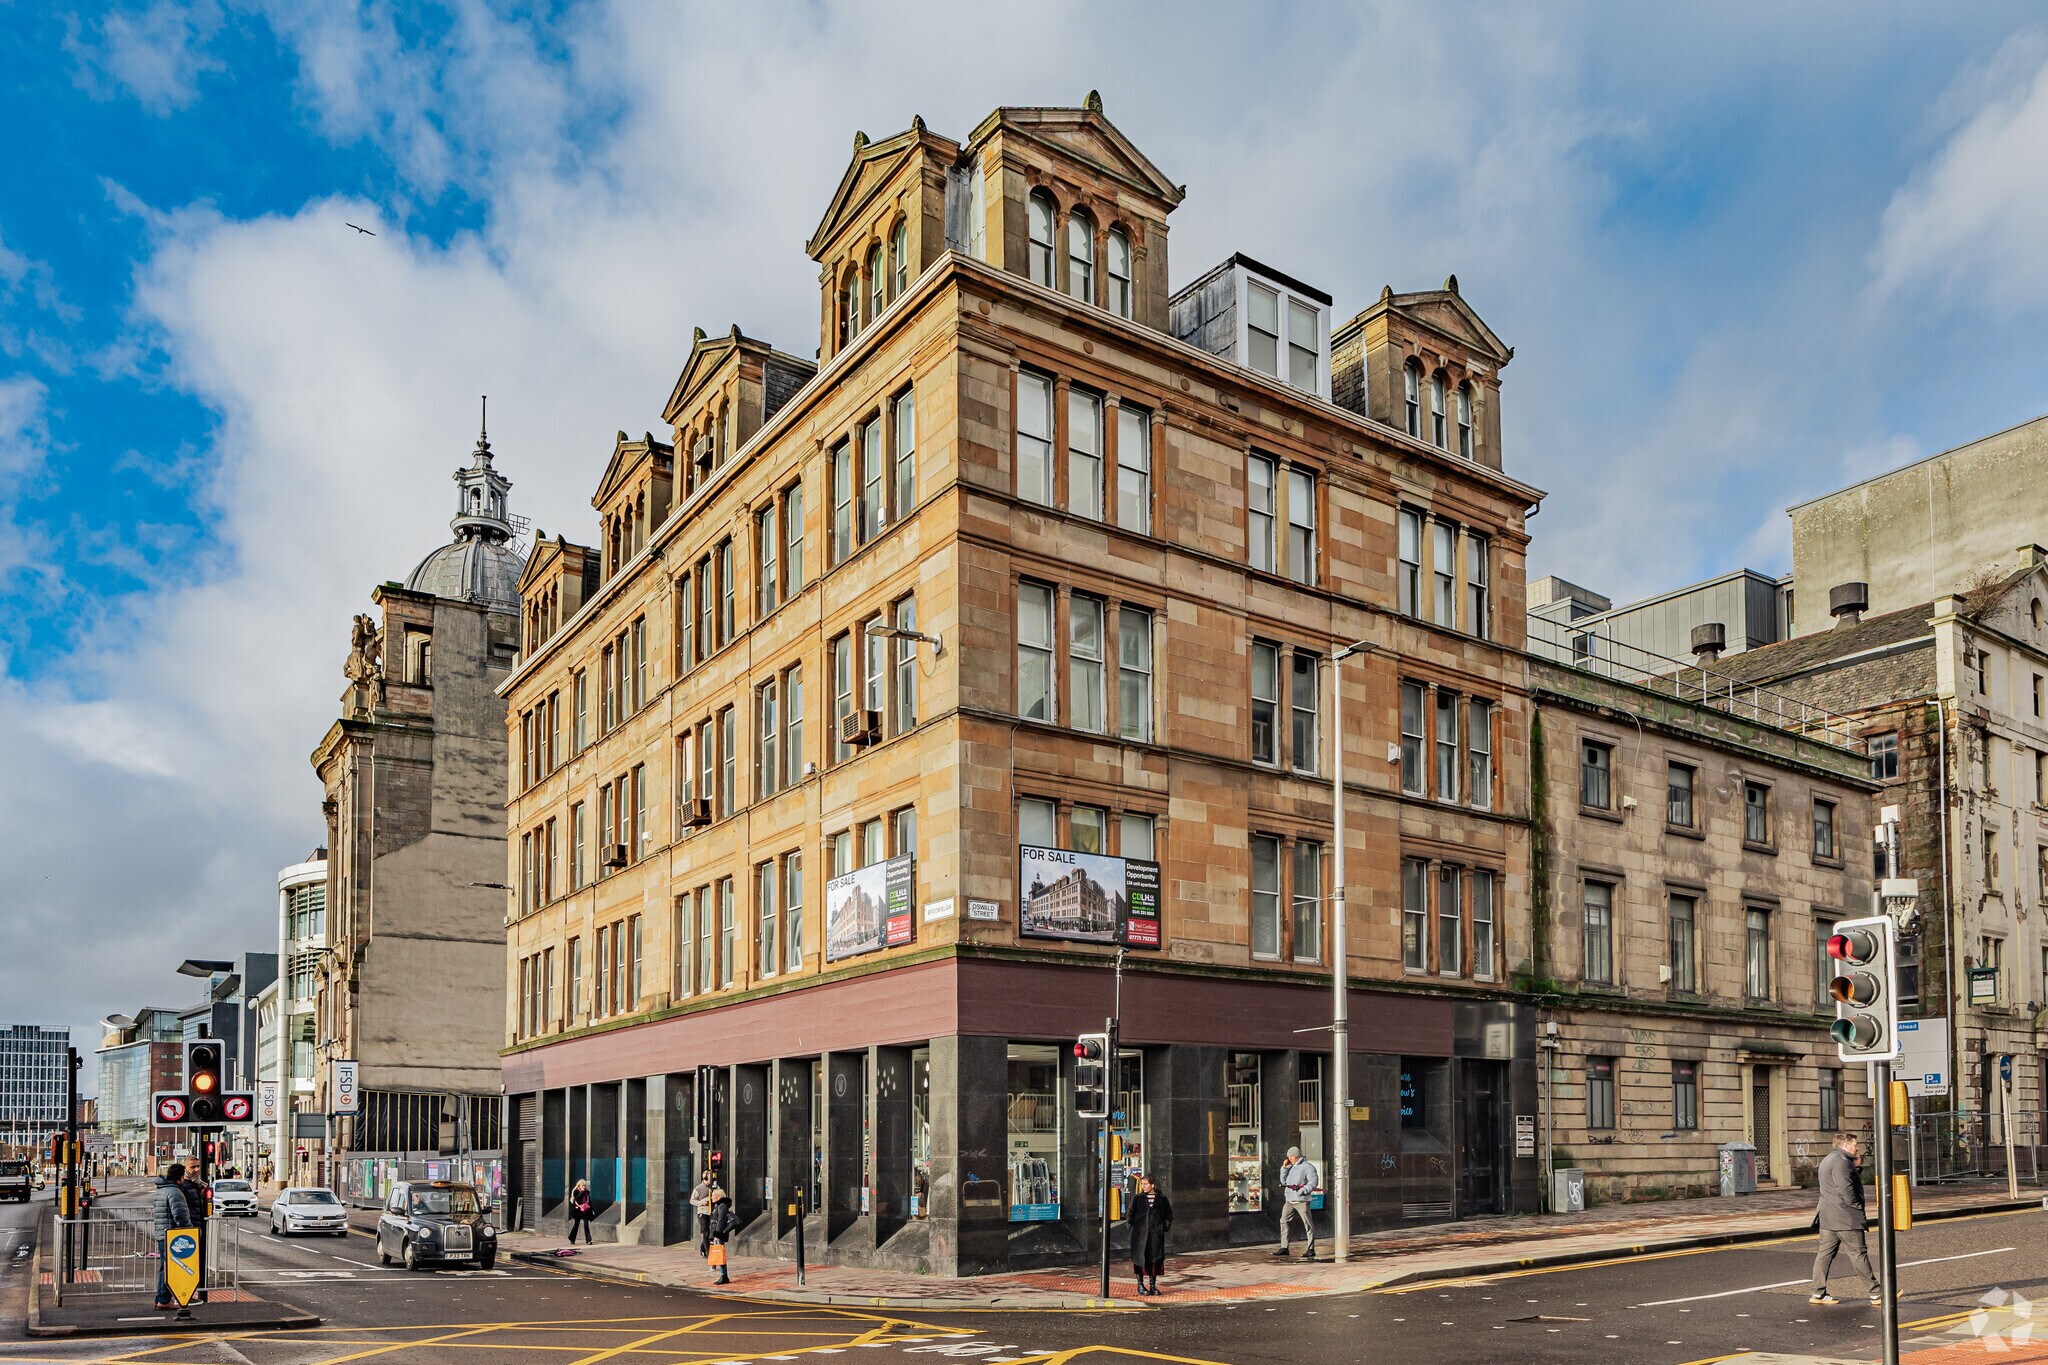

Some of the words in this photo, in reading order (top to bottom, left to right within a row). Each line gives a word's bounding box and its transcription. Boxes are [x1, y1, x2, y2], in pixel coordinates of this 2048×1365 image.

[1022, 848, 1045, 860] FOR
[1048, 851, 1076, 864] SALE
[887, 858, 911, 871] Development
[1126, 863, 1158, 873] Development
[887, 867, 909, 878] Opportunity
[1126, 871, 1156, 881] Opportunity
[827, 880, 839, 893] FOR
[839, 874, 856, 888] SALE
[972, 903, 995, 911] OSWALD
[973, 910, 994, 918] STREET
[340, 1067, 352, 1094] IFSD
[1926, 1075, 1934, 1084] P
[264, 1086, 275, 1108] IFSD
